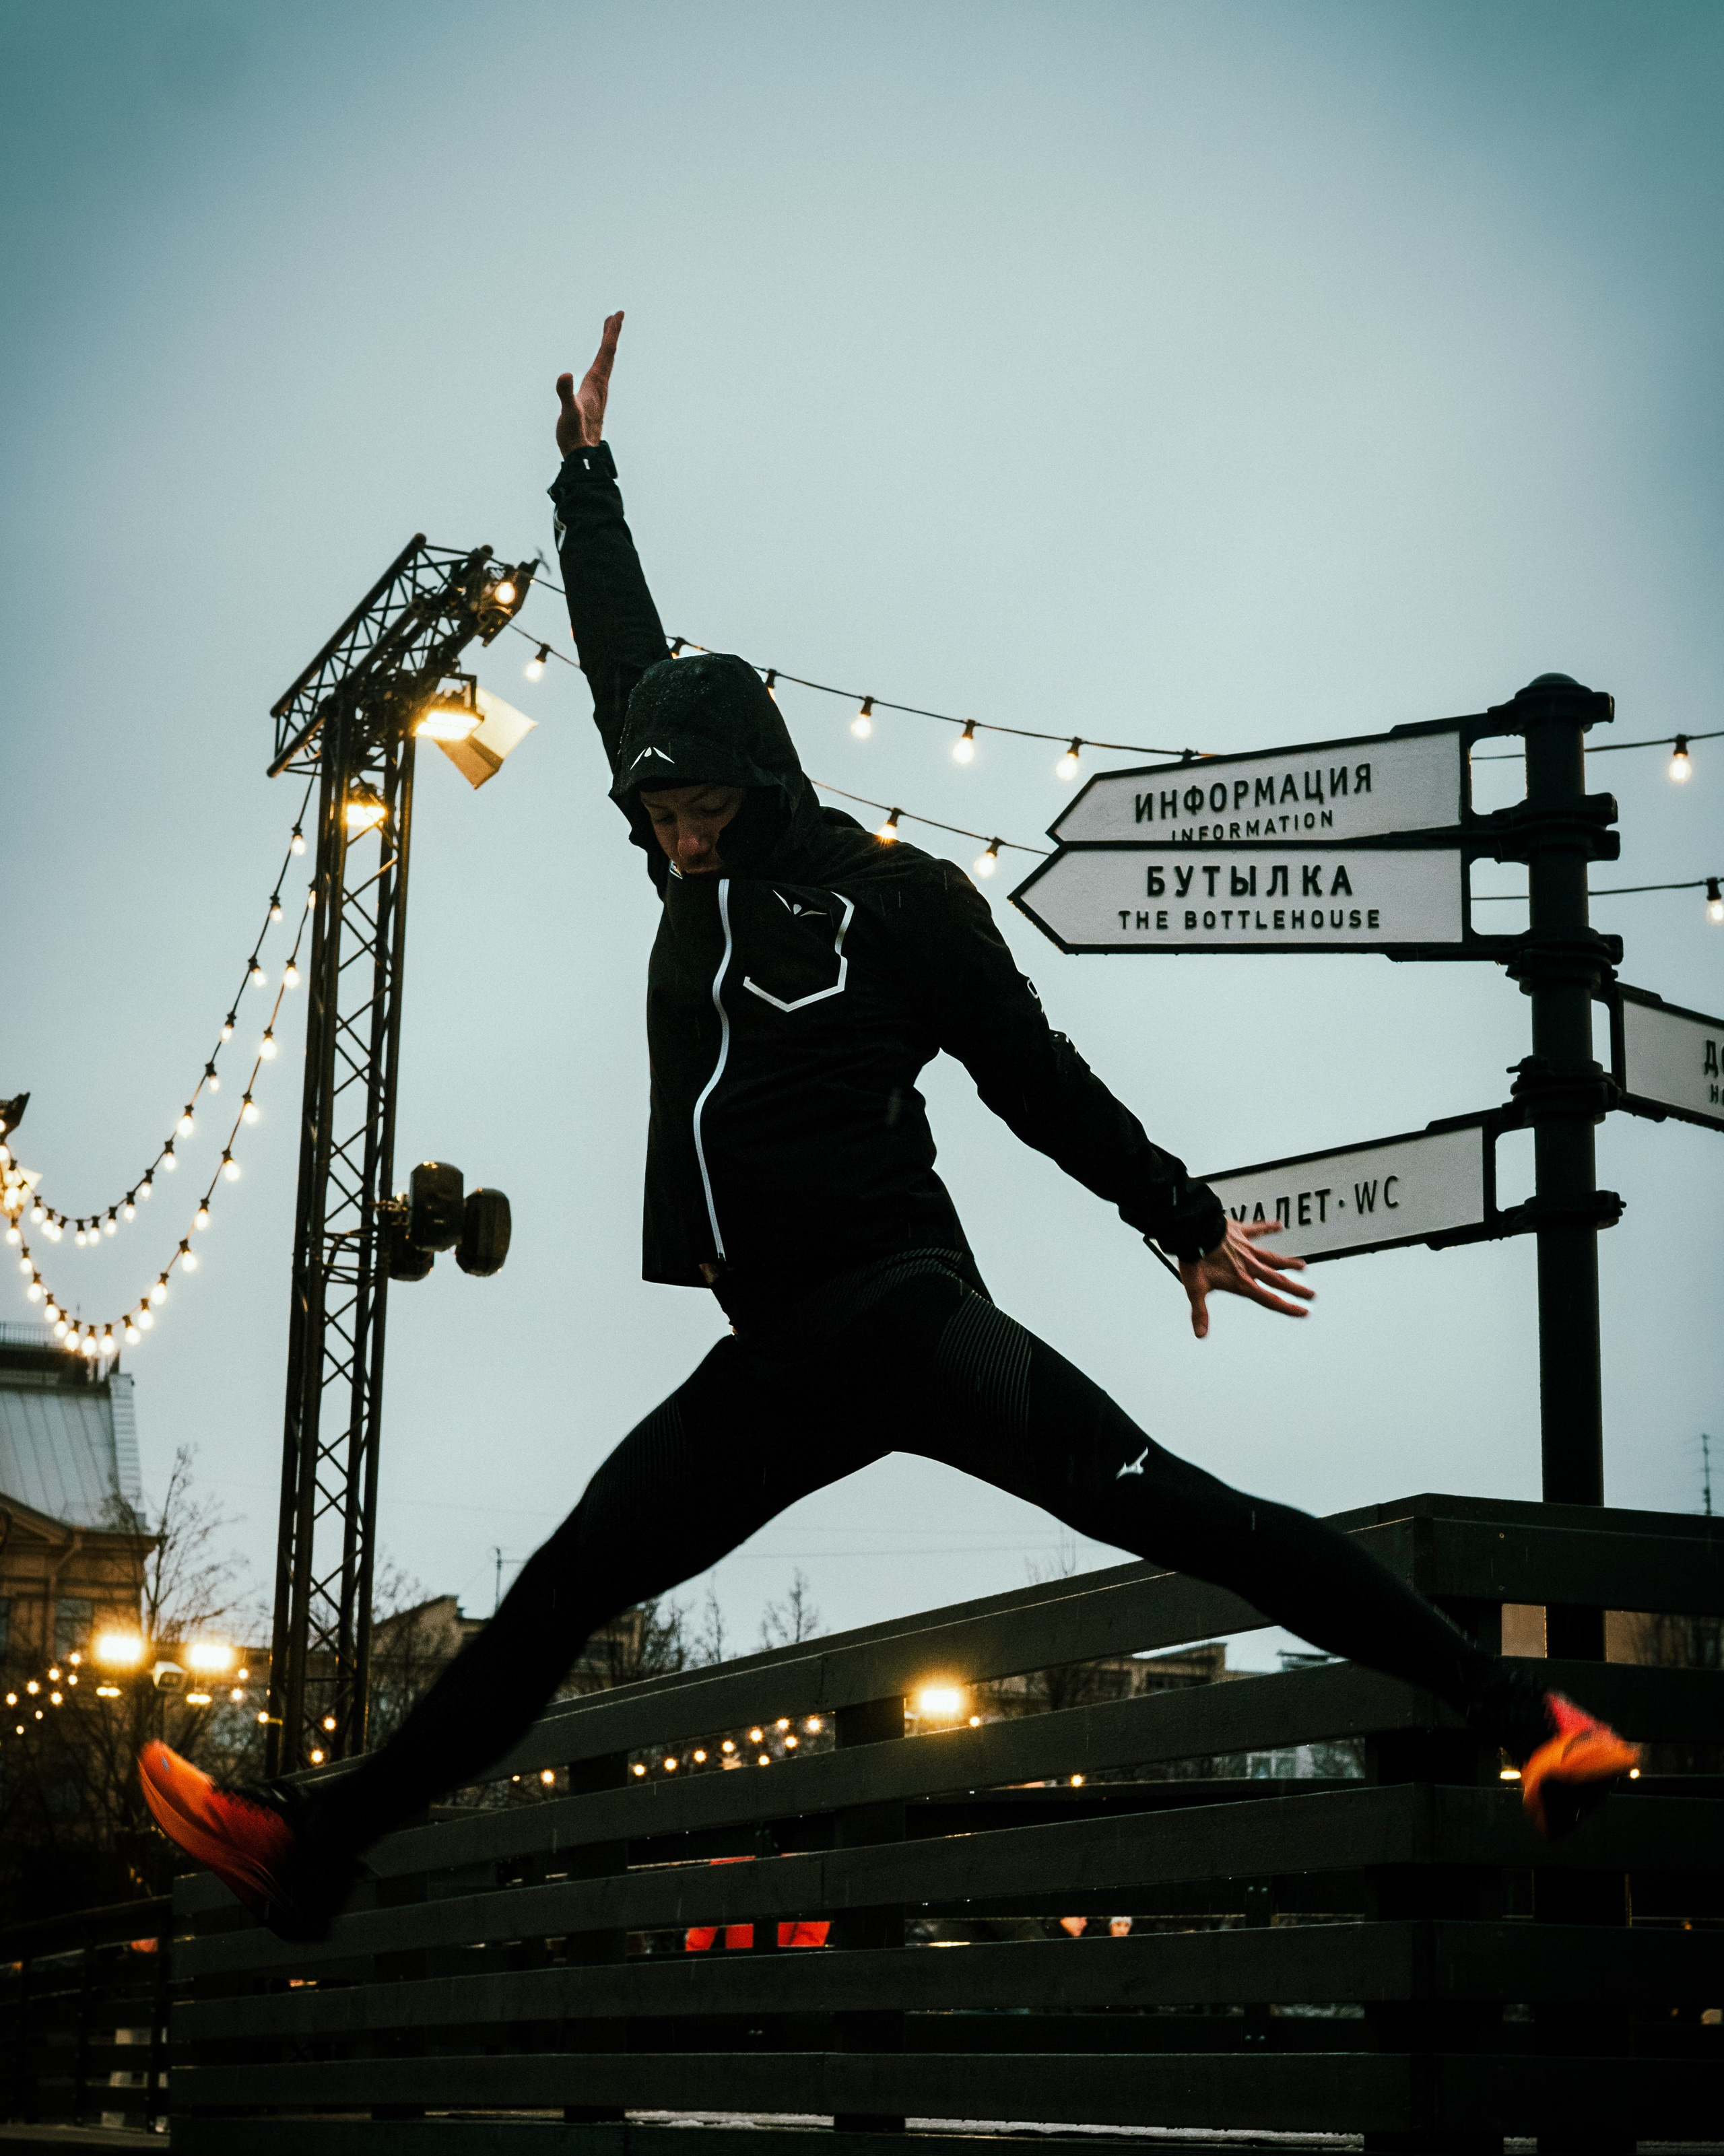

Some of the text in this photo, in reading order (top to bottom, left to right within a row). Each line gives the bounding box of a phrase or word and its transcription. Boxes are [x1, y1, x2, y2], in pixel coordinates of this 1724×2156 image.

[1134, 763, 1372, 824] ИНФОРМАЦИЯ
[1172, 809, 1333, 842] INFORMATION
[1146, 865, 1354, 898] БУТЫЛКА
[1118, 909, 1381, 931] THE BOTTLEHOUSE
[1230, 1188, 1331, 1229] УАЛЕТ
[1354, 1176, 1399, 1214] WC
